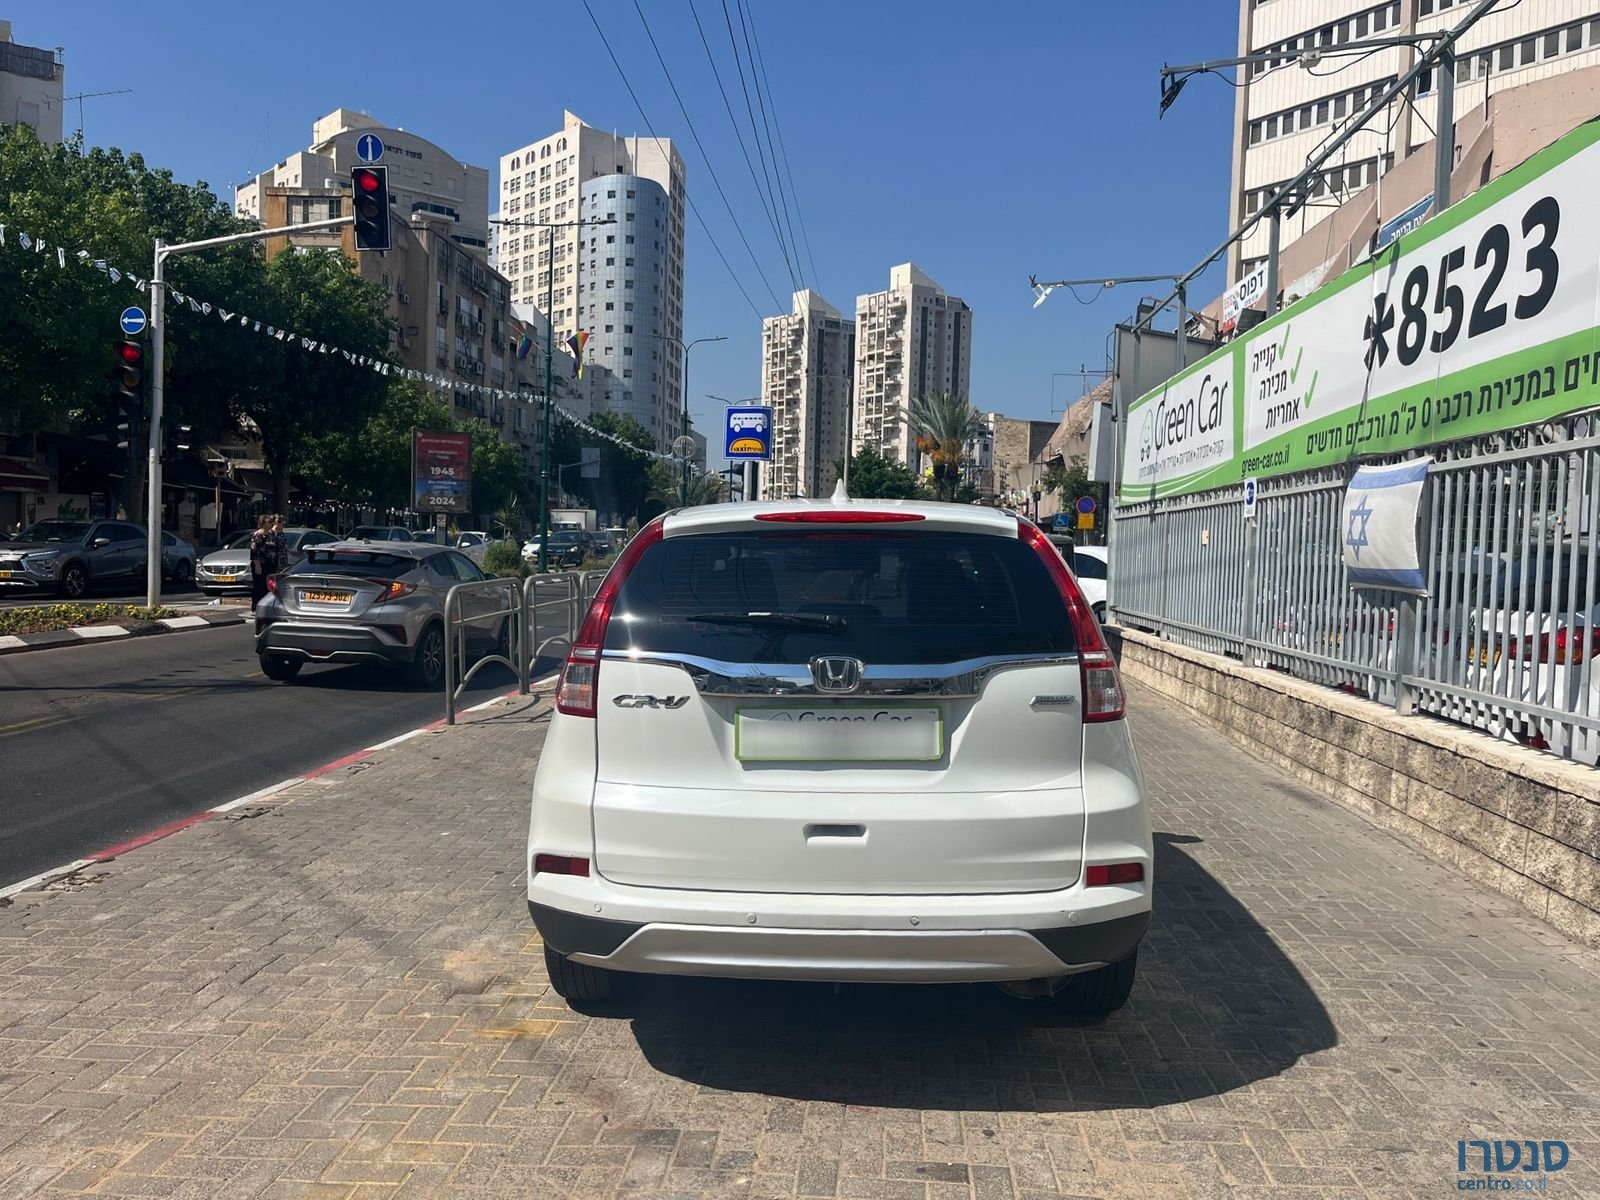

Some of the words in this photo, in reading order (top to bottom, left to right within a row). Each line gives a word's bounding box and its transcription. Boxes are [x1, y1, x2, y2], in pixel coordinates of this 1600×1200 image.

[1240, 270, 1264, 301] דפוס
[1253, 342, 1277, 373] קנייה
[1260, 369, 1287, 400] מכירה
[1477, 365, 1555, 415] במכירת
[1155, 398, 1194, 451] Green
[1198, 374, 1228, 434] Car
[1266, 397, 1301, 430] אחריות
[1437, 391, 1473, 425] רכבי
[1306, 426, 1342, 455] חדשים
[430, 467, 454, 476] 1945
[1241, 443, 1290, 477] green-car.co.il
[429, 497, 455, 505] 2024
[612, 694, 691, 710] CR-V
